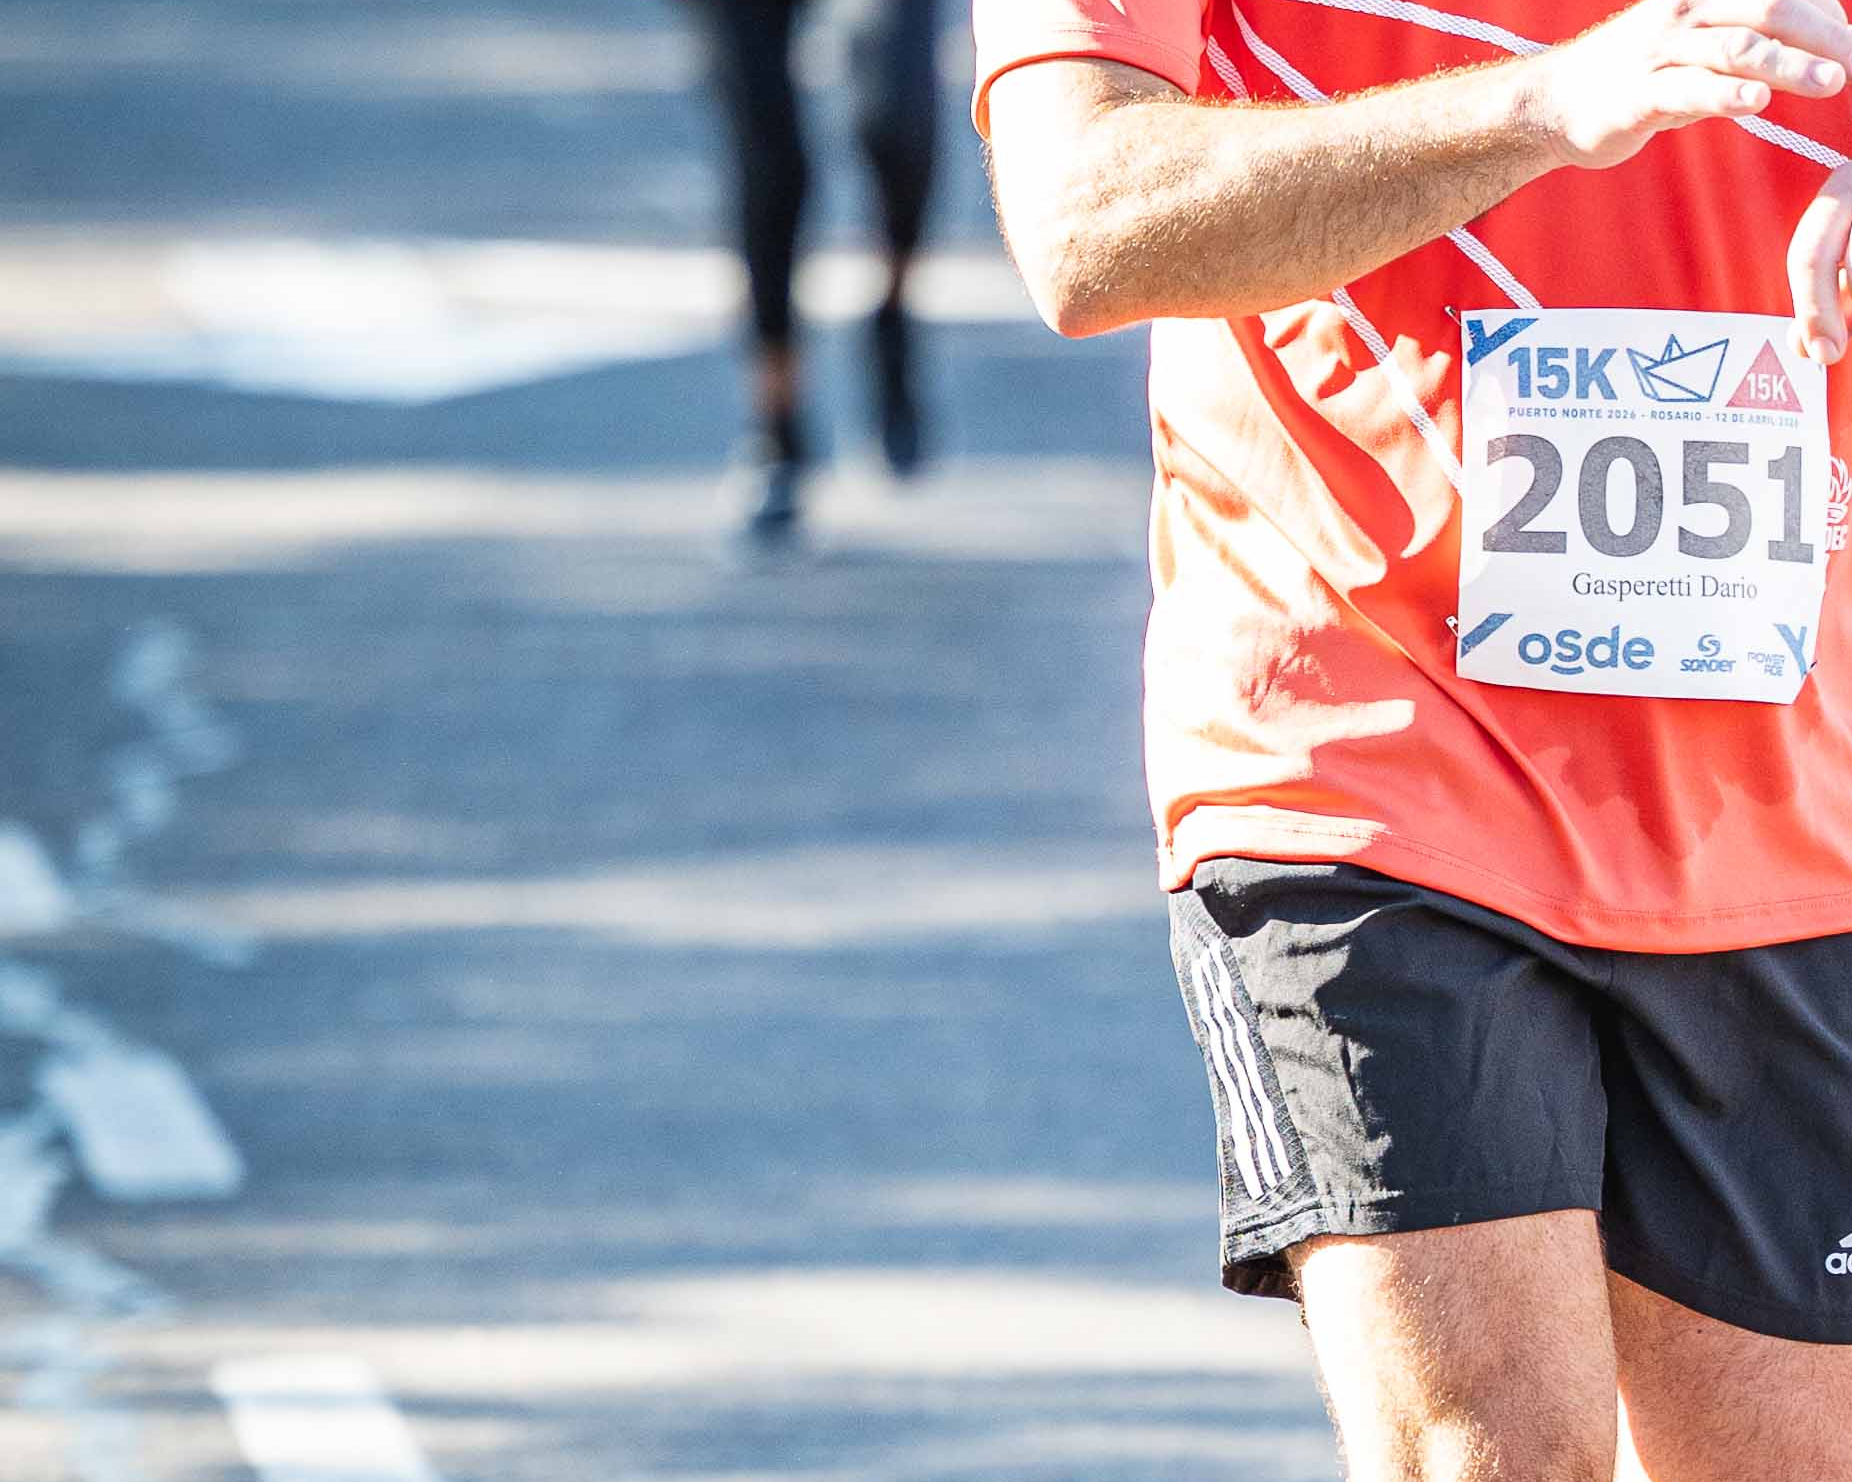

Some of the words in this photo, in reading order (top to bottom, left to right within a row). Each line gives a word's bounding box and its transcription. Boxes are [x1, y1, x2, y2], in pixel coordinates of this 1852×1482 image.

[1508, 347, 1618, 401] 15K
[1746, 373, 1790, 403] 15K
[1509, 407, 1557, 418] PUERTO
[1562, 408, 1603, 419] NORTE
[1608, 409, 1637, 420] 2026
[1650, 410, 1702, 422] ROSARIO
[1715, 413, 1728, 423] 12
[1732, 413, 1745, 423] DE
[1483, 434, 1814, 564] 2051
[1572, 572, 1691, 602] Gasperetti
[1701, 575, 1758, 599] Dario
[1518, 625, 1655, 671] osde
